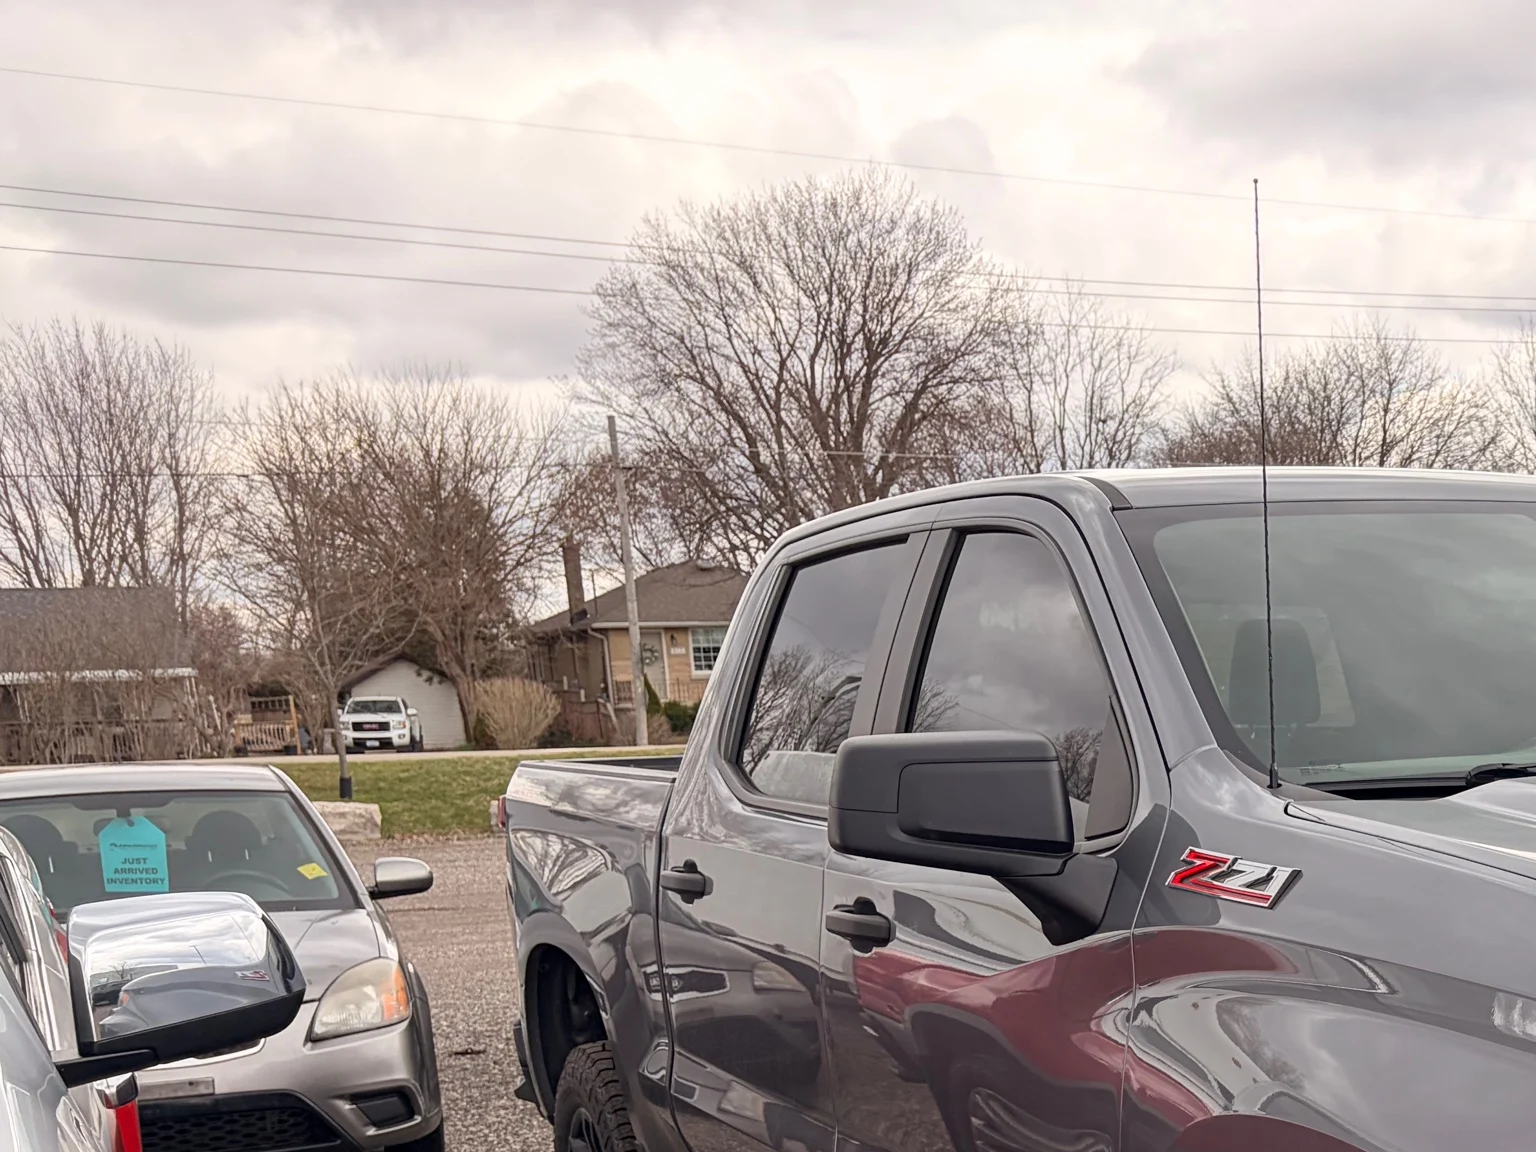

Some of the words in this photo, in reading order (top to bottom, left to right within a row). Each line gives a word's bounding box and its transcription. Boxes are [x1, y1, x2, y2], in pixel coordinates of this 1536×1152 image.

[121, 857, 148, 865] JUST
[113, 867, 158, 875] ARRIVED
[106, 877, 166, 885] INVENTORY
[1165, 846, 1302, 910] Z71
